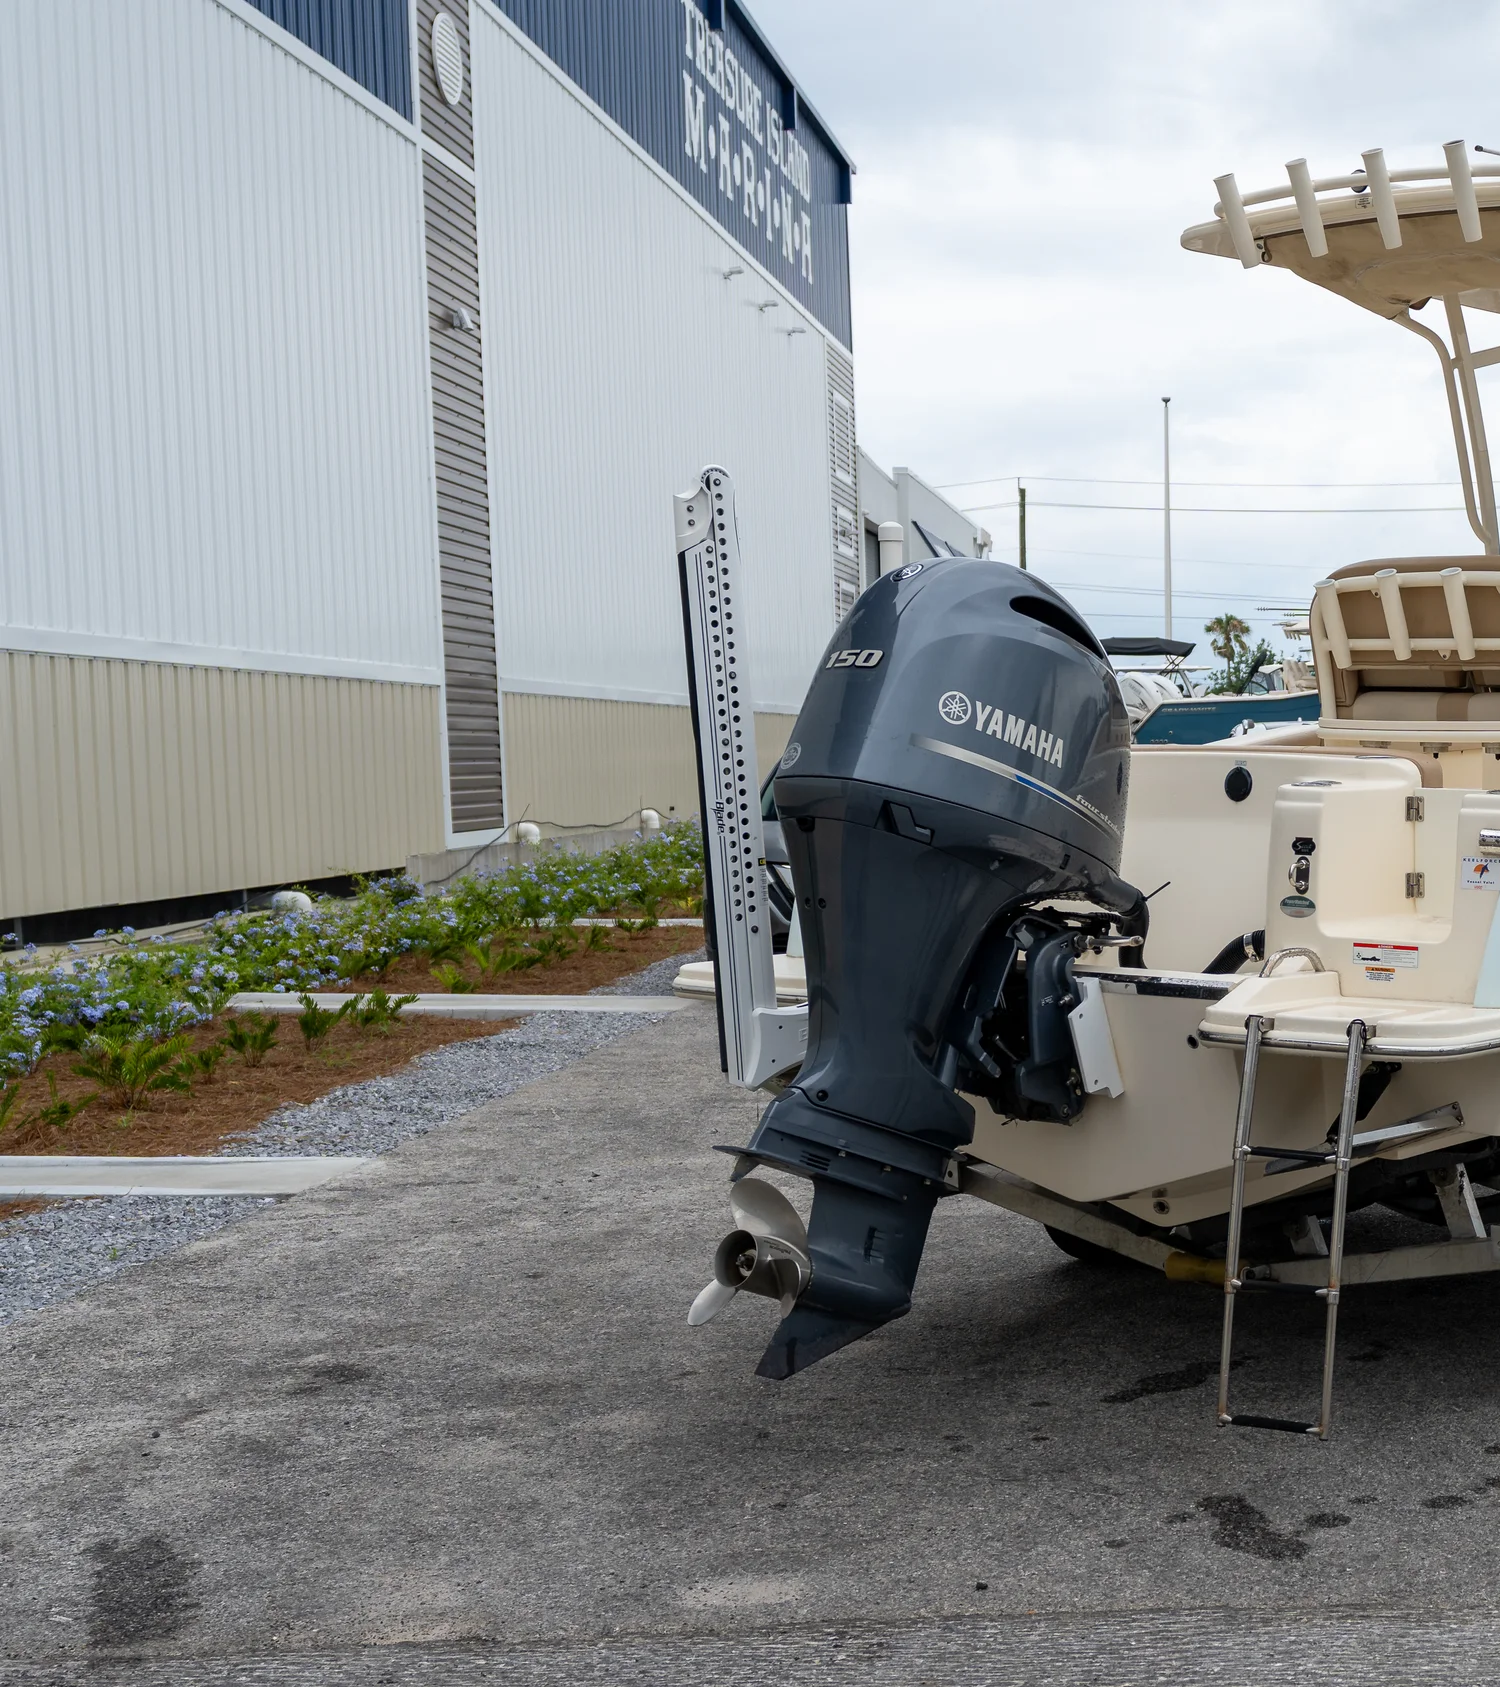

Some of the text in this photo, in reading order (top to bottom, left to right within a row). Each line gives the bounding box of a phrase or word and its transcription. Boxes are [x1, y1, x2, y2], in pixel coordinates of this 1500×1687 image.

[680, 0, 810, 204] TREASURE ISLAND
[825, 649, 884, 669] 150
[975, 700, 1064, 769] YAMAHA
[710, 801, 726, 833] Blade
